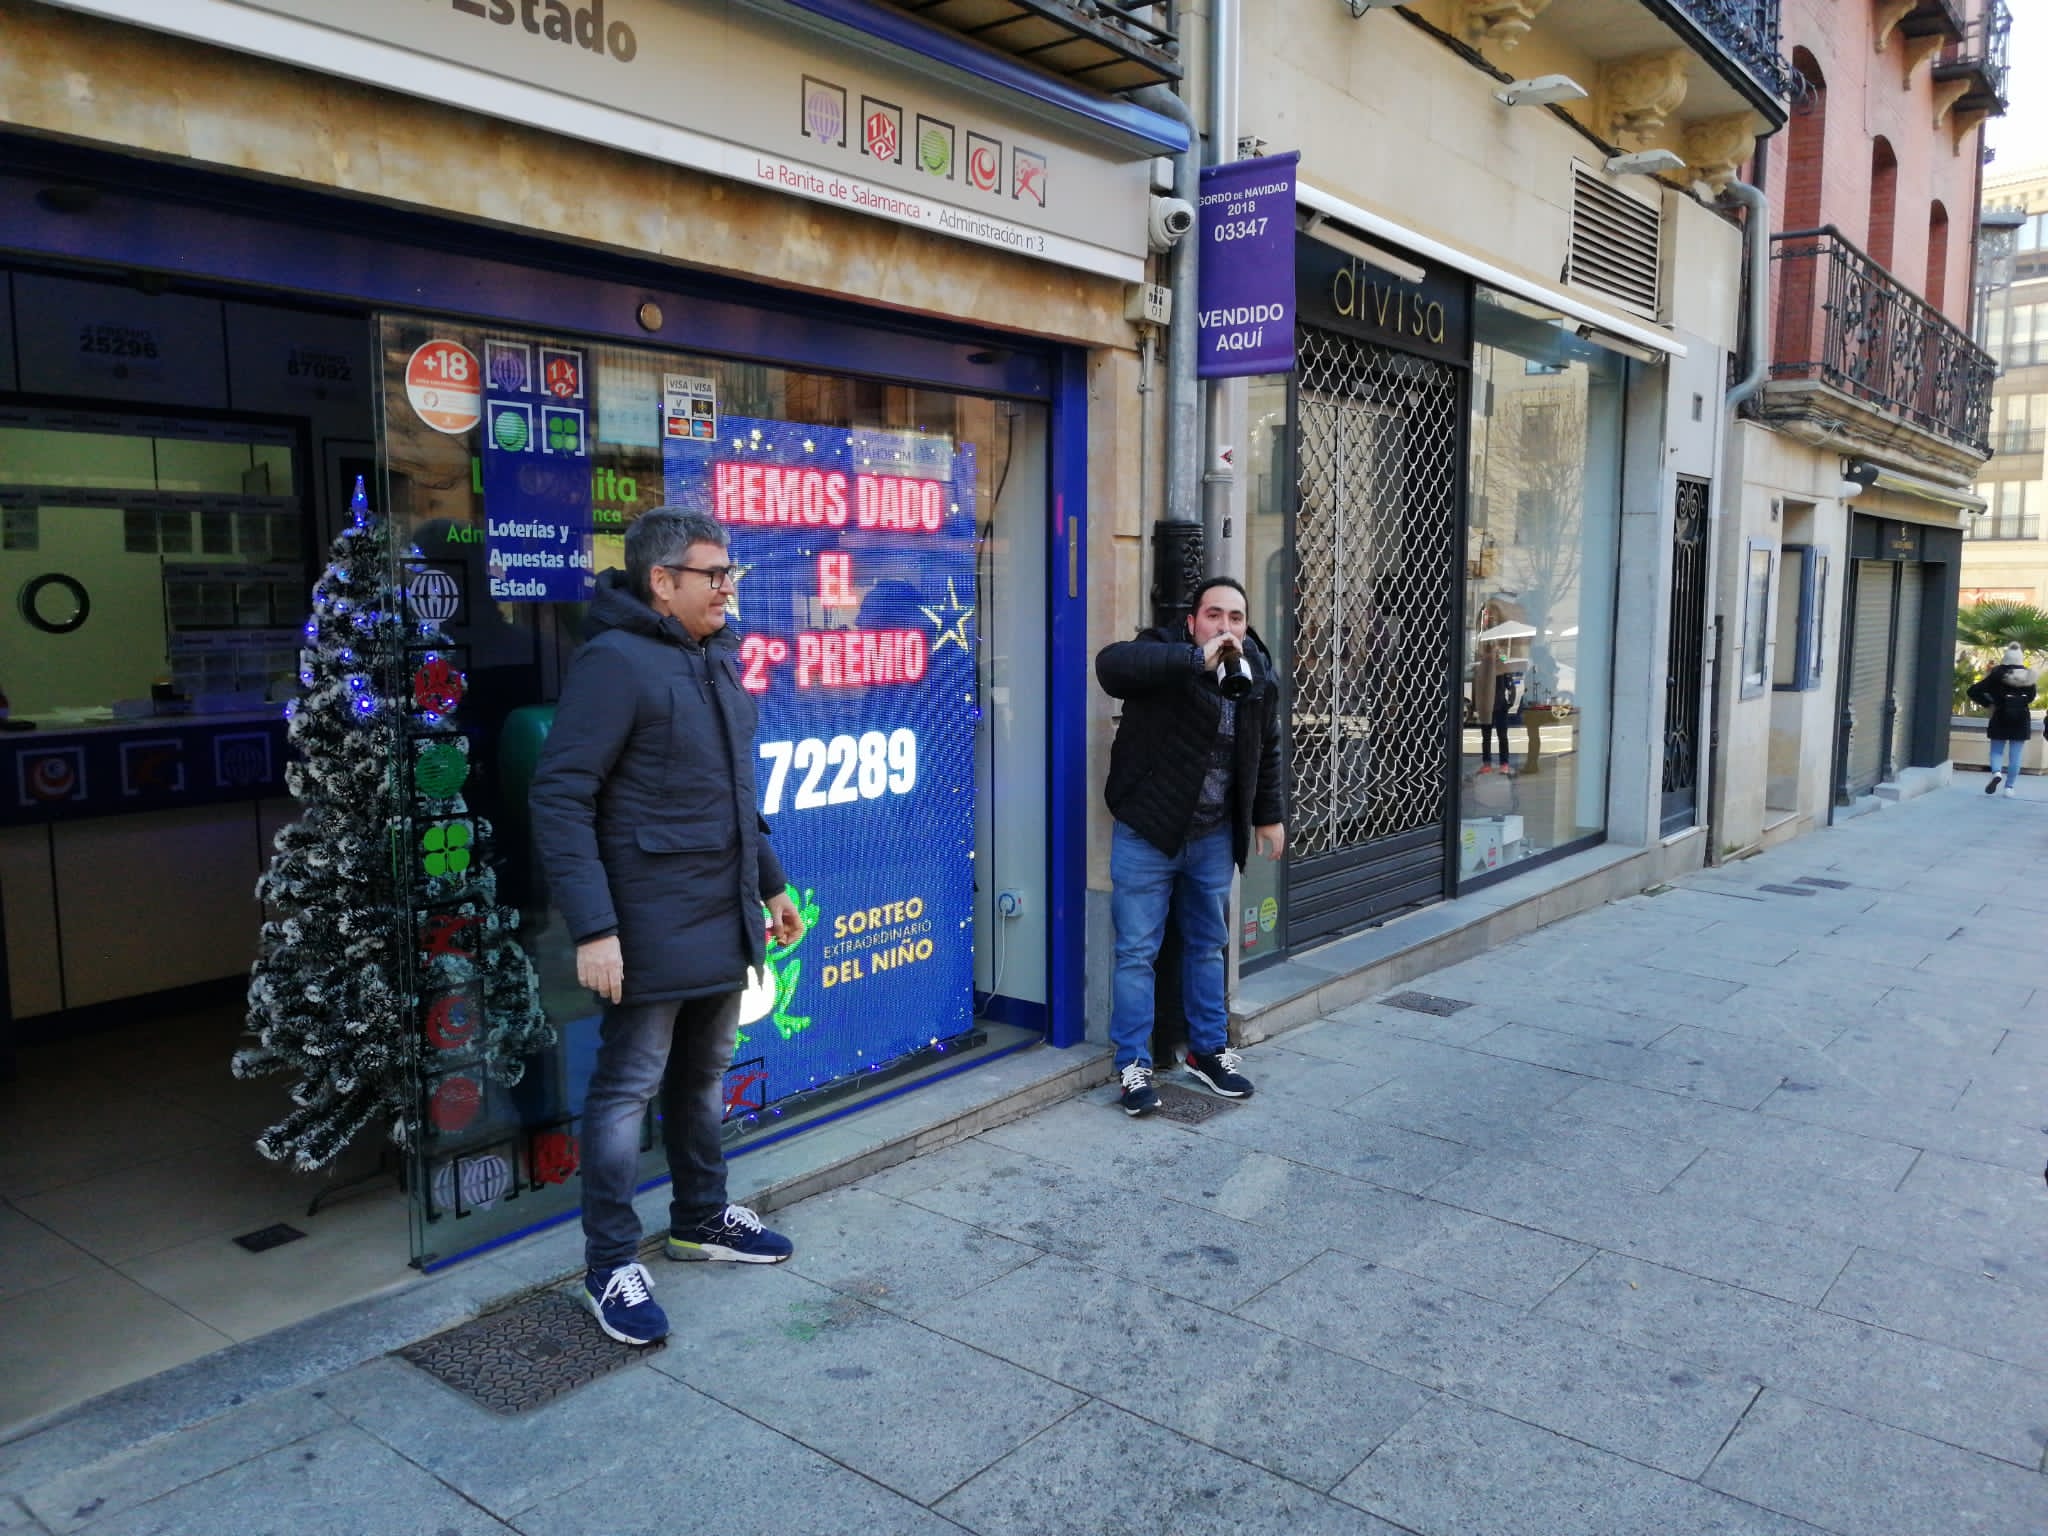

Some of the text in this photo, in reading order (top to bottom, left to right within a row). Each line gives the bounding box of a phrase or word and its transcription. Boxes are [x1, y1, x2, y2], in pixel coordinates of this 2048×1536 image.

[452, 0, 638, 63] stado
[757, 158, 774, 180] La
[779, 164, 824, 194] Ranita
[829, 177, 848, 200] de
[852, 185, 920, 218] Salamanca
[1244, 182, 1289, 199] NAVIDAD
[1227, 200, 1256, 217] 2018
[1214, 217, 1269, 242] 03347
[1198, 303, 1284, 329] VENDIDO
[1334, 256, 1445, 344] divisa
[1215, 326, 1264, 352] AQUÍ
[423, 350, 468, 381] +18
[670, 380, 712, 392] VISA VISA
[715, 463, 943, 532] HEMOS DADO
[488, 518, 556, 539] Loterías
[559, 525, 569, 544] y
[489, 548, 593, 572] Apuestas del
[490, 578, 547, 596] Estado
[819, 552, 857, 607] EL
[798, 629, 927, 689] PREMIO
[759, 728, 917, 815] 72289
[834, 896, 923, 939] SORTEO
[823, 919, 932, 959] EXTRAORDINARIO
[822, 937, 933, 988] DEL NIÑO
